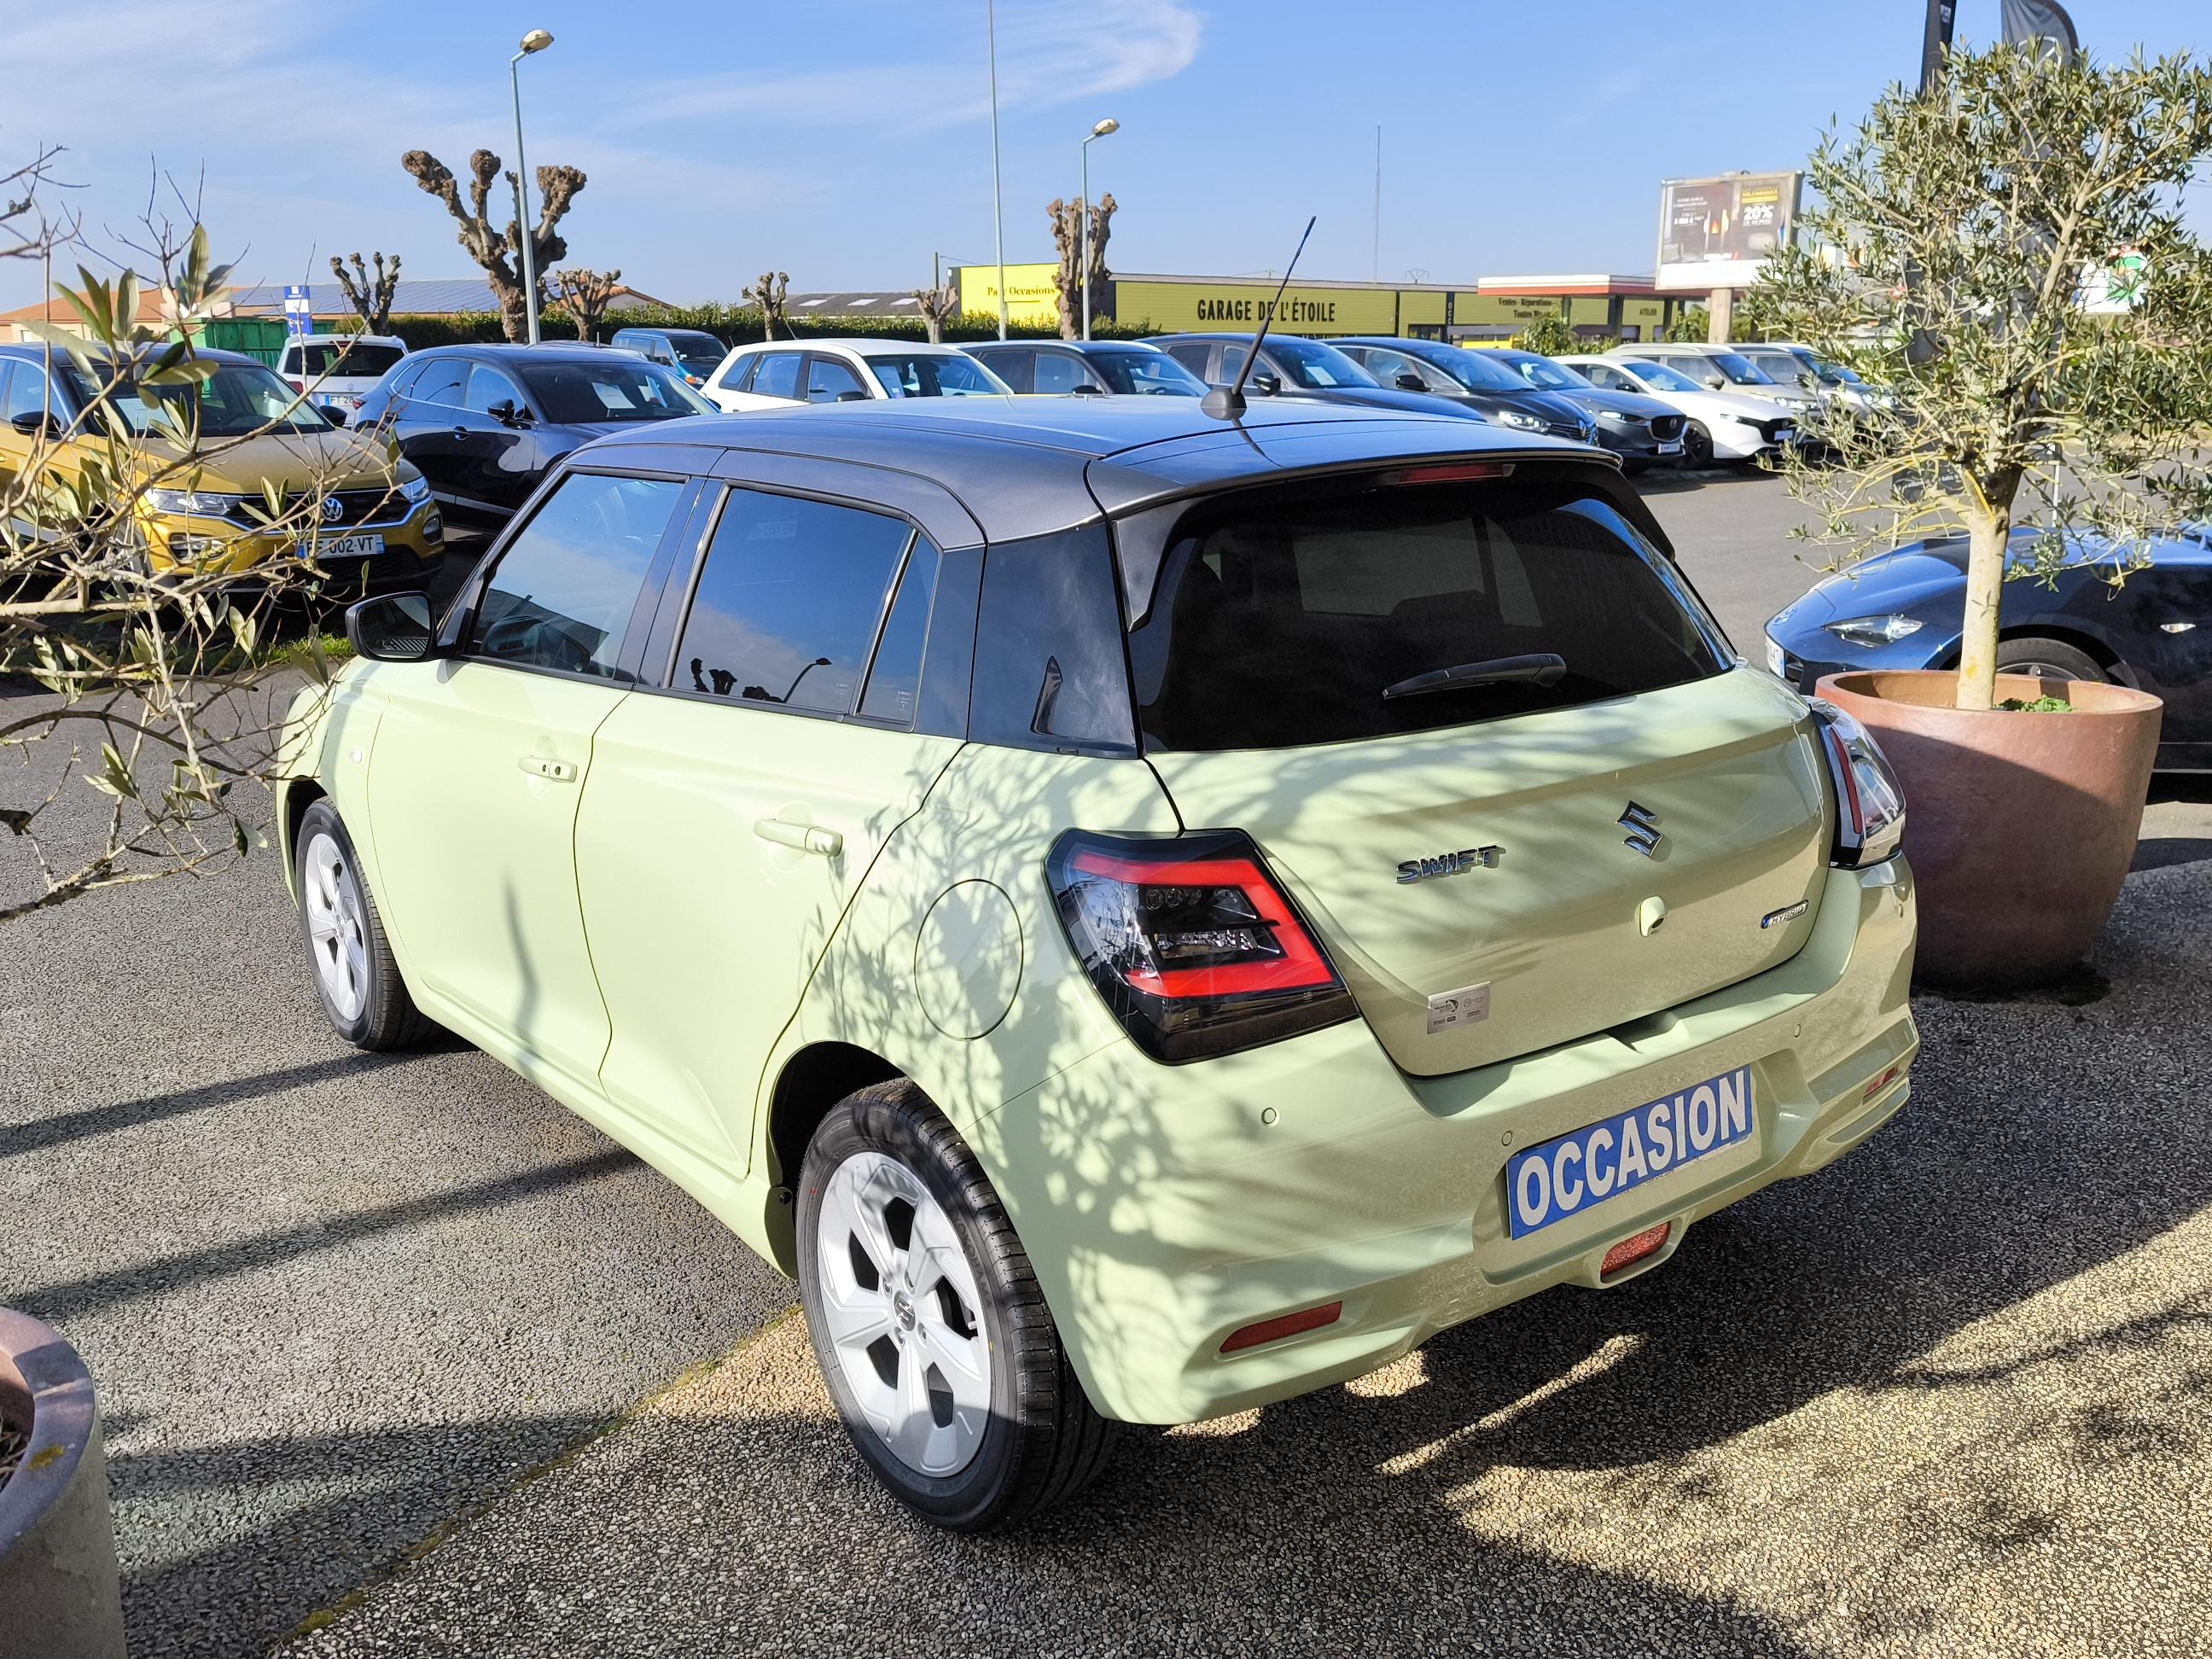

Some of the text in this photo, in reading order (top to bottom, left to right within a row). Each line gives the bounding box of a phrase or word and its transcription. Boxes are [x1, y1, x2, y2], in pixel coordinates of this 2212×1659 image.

[1010, 286, 1055, 295] Occasions
[1197, 296, 1336, 322] GARAGE DE L'ÉTOILE
[1395, 844, 1499, 883] SWIFT
[1770, 905, 1804, 926] HYBRID
[1516, 1069, 1747, 1227] OCCASION
